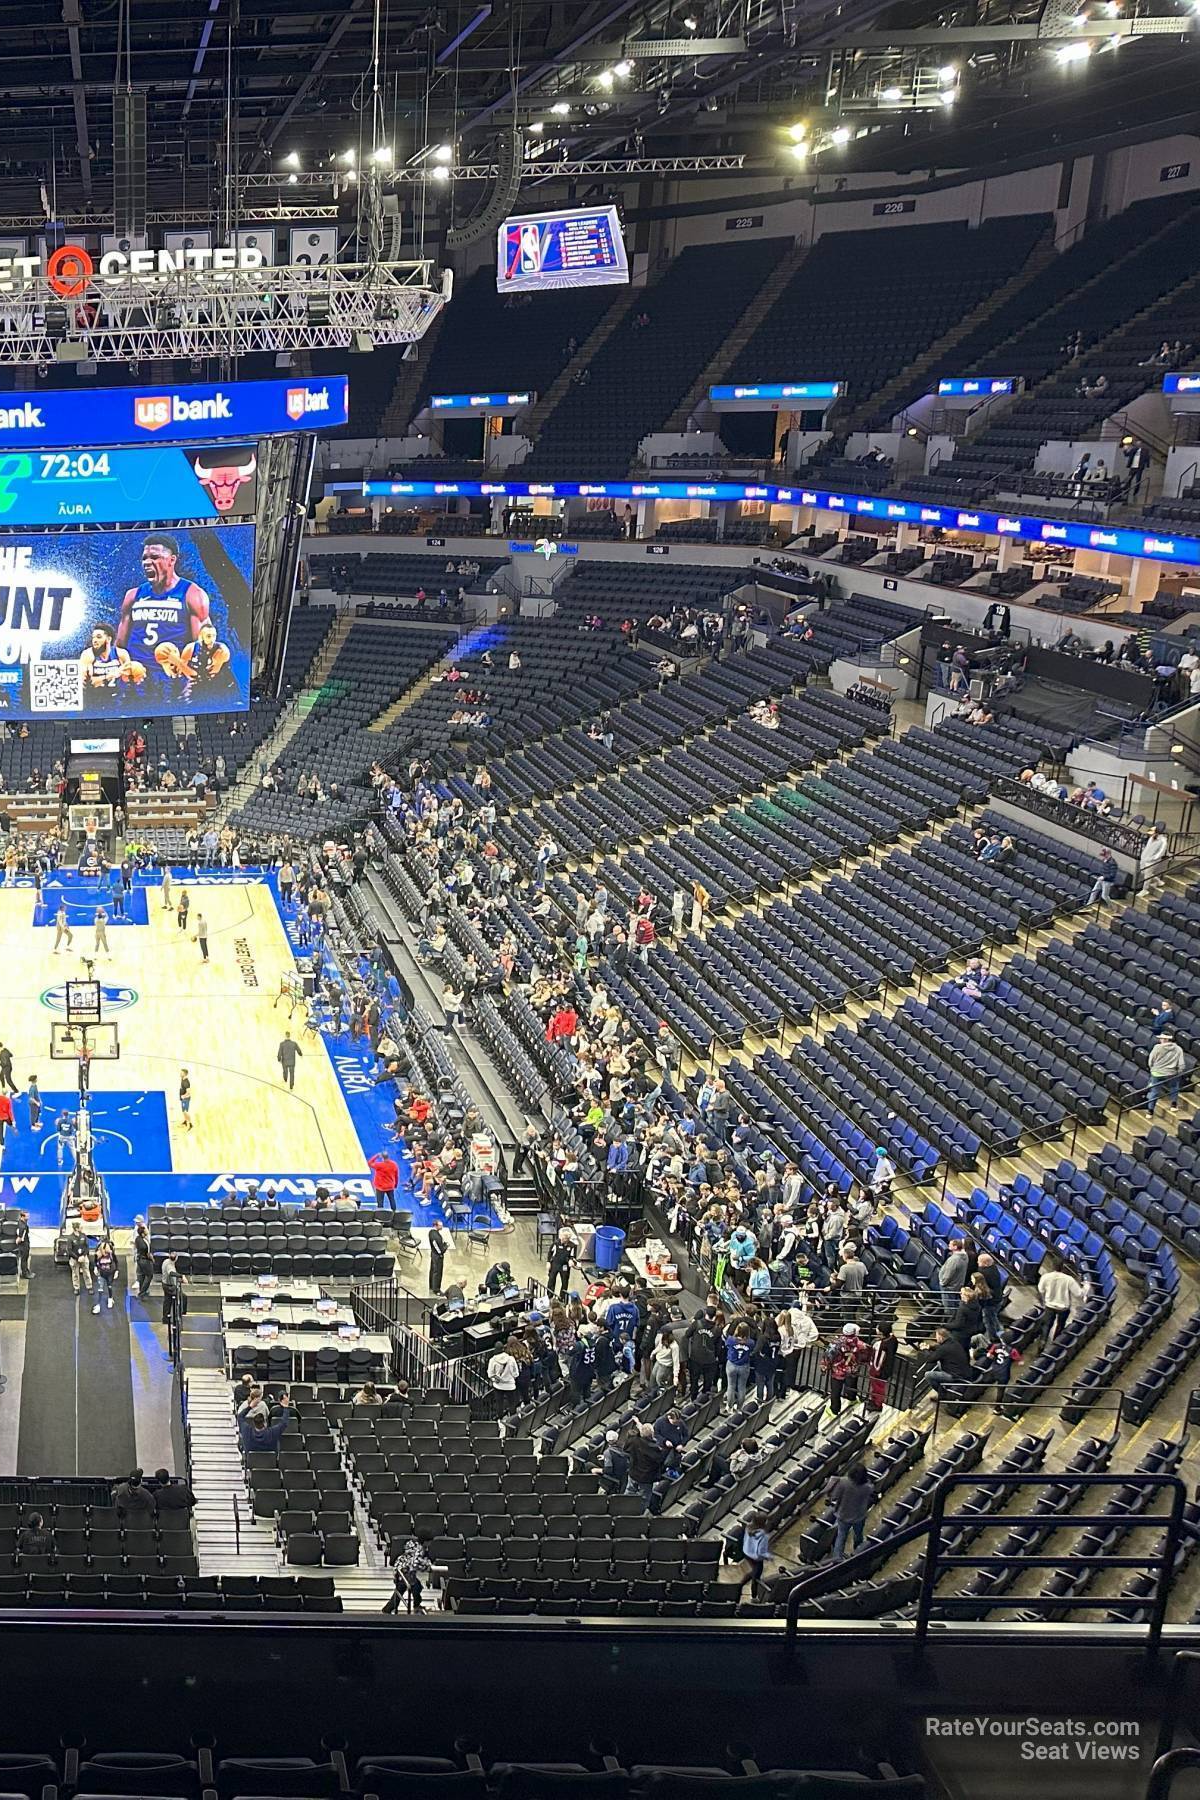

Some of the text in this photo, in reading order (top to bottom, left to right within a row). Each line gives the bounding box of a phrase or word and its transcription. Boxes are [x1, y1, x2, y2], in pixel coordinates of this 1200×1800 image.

[1167, 166, 1181, 180] 227
[99, 248, 263, 285] CENTER
[40, 453, 111, 480] 72:04
[132, 608, 179, 623] MINNESOTA
[142, 622, 159, 646] 5
